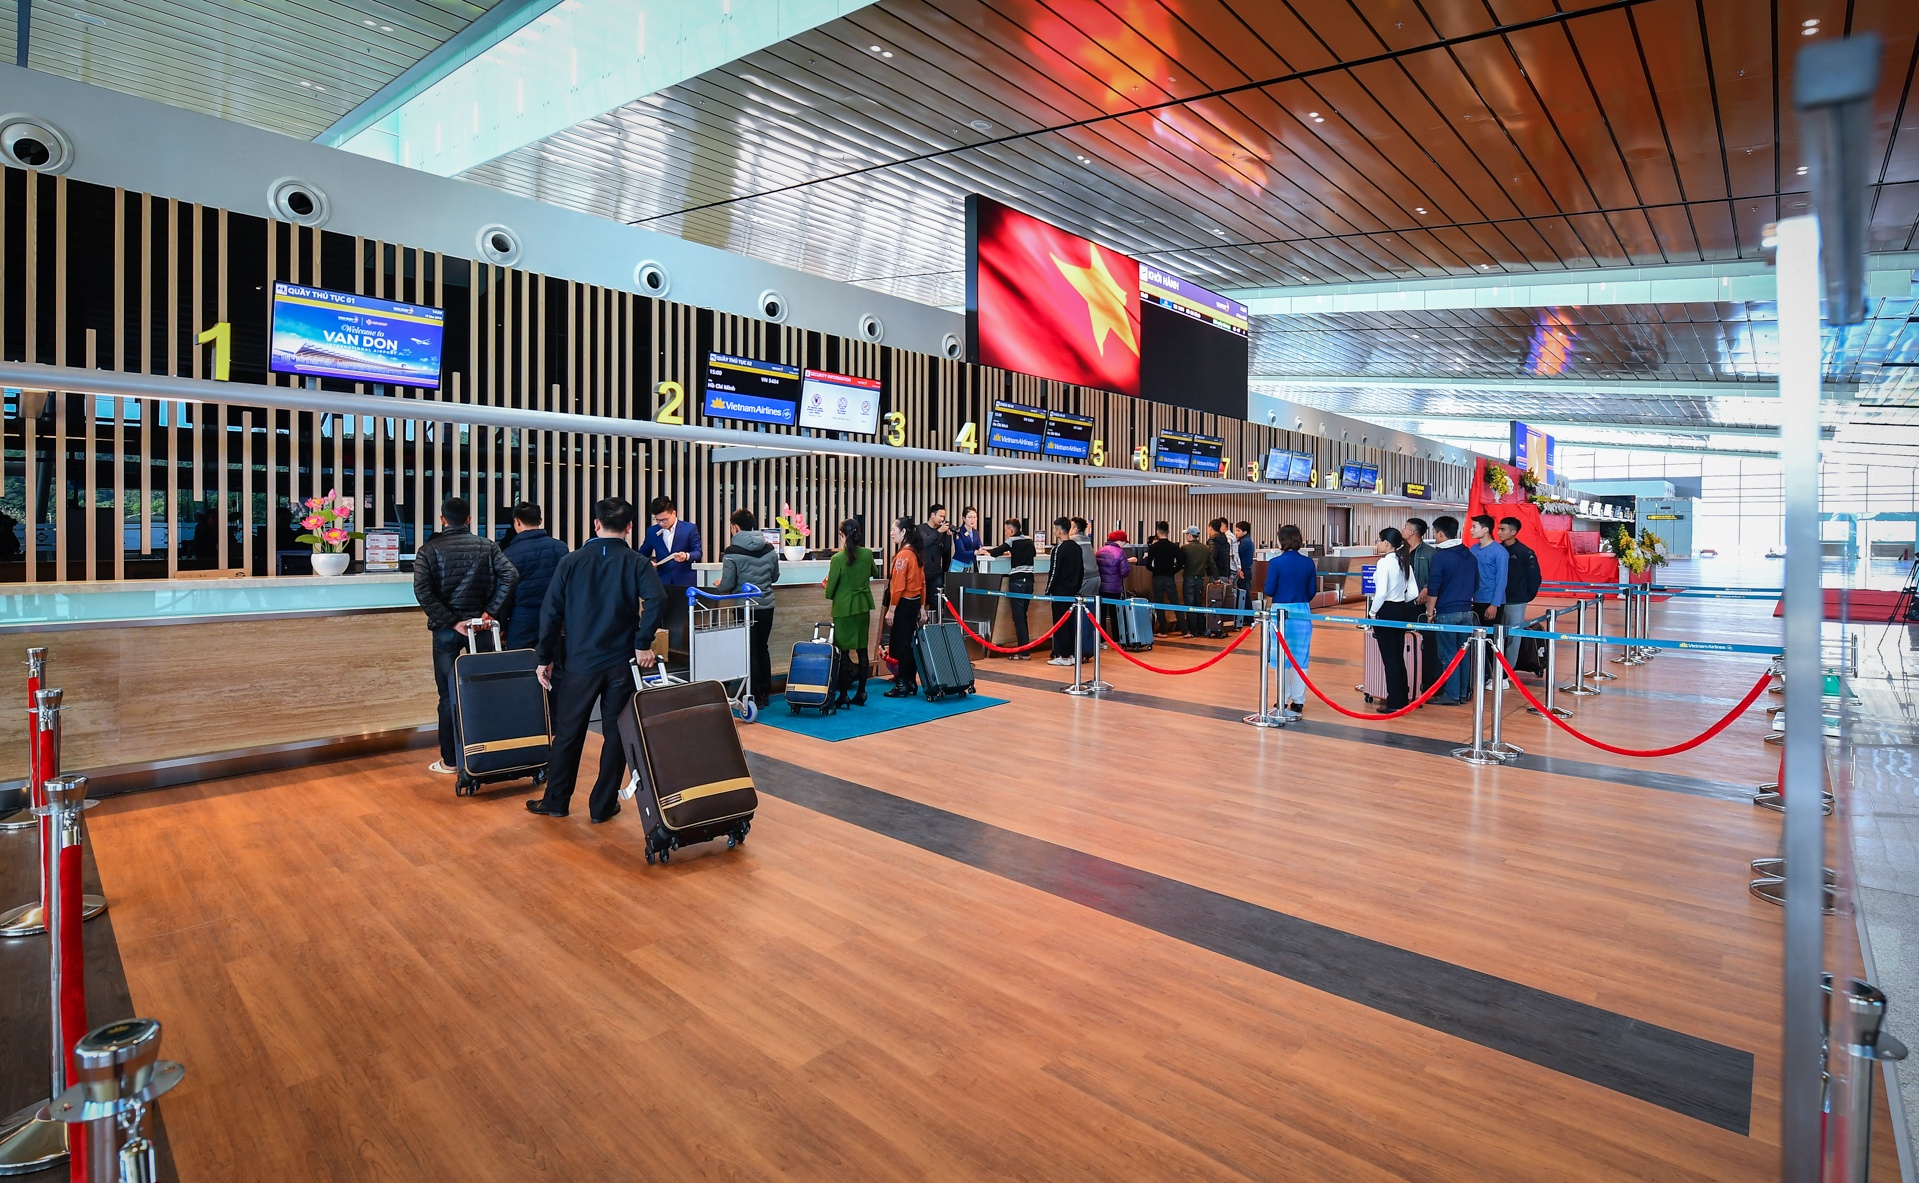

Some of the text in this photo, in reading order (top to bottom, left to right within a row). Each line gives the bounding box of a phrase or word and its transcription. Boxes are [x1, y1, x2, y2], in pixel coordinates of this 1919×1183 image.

[323, 330, 398, 351] VAN DON
[341, 324, 376, 337] Welcome
[197, 321, 231, 381] 1
[326, 343, 371, 353] INTERNATIONAL
[656, 381, 684, 425] 2
[887, 411, 905, 447] 3
[959, 422, 978, 454] 4
[1093, 440, 1104, 467] 5
[1139, 446, 1149, 471] 6
[1221, 457, 1230, 479] 7
[1252, 461, 1259, 482] 8
[1310, 469, 1318, 488] 9
